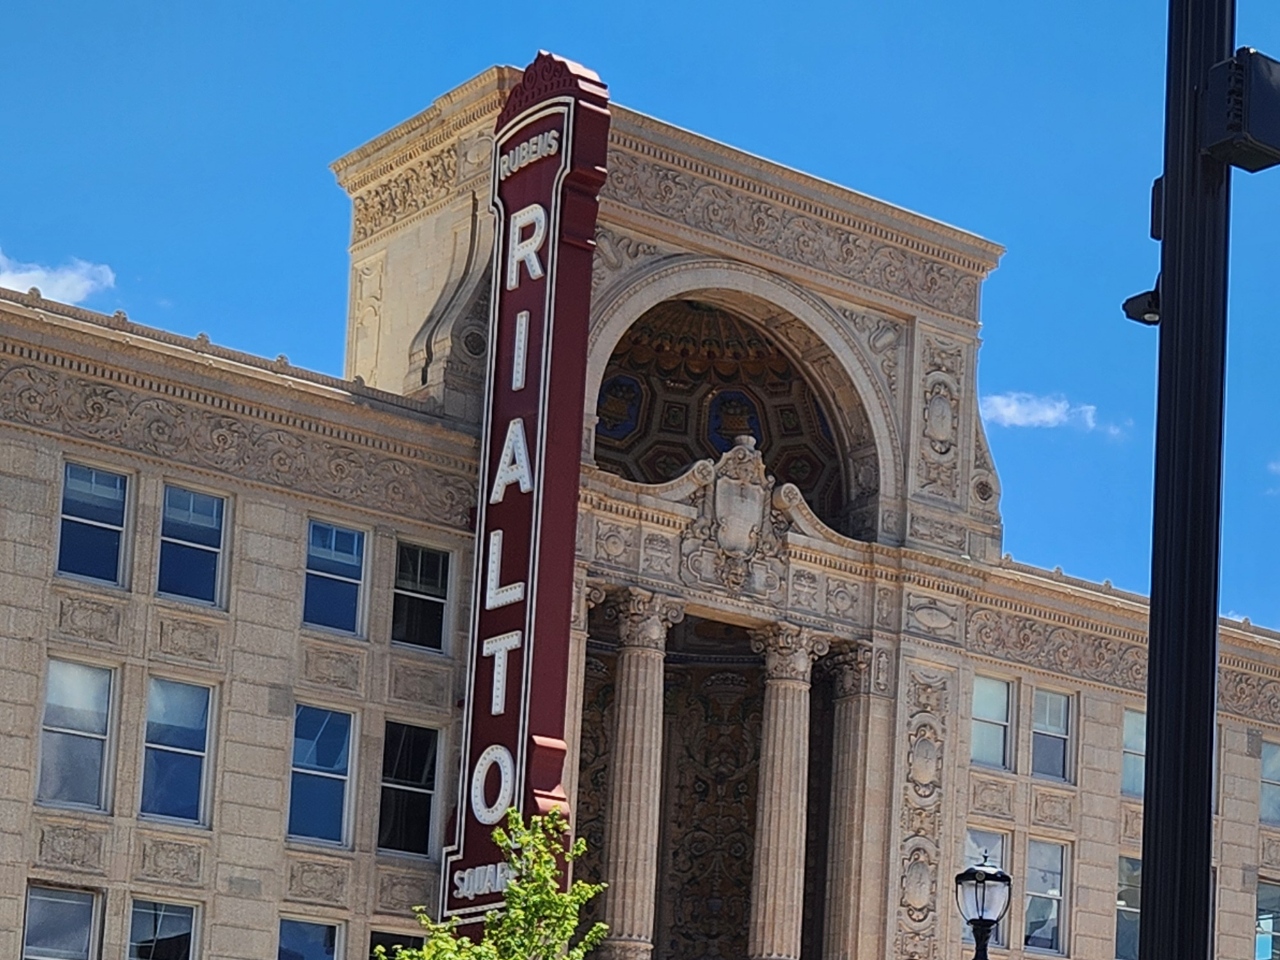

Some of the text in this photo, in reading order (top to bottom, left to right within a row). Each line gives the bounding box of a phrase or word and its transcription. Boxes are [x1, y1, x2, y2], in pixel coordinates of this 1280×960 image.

[499, 129, 560, 181] RUBENS
[471, 203, 549, 827] RIALTO
[453, 861, 519, 900] SQUAR
